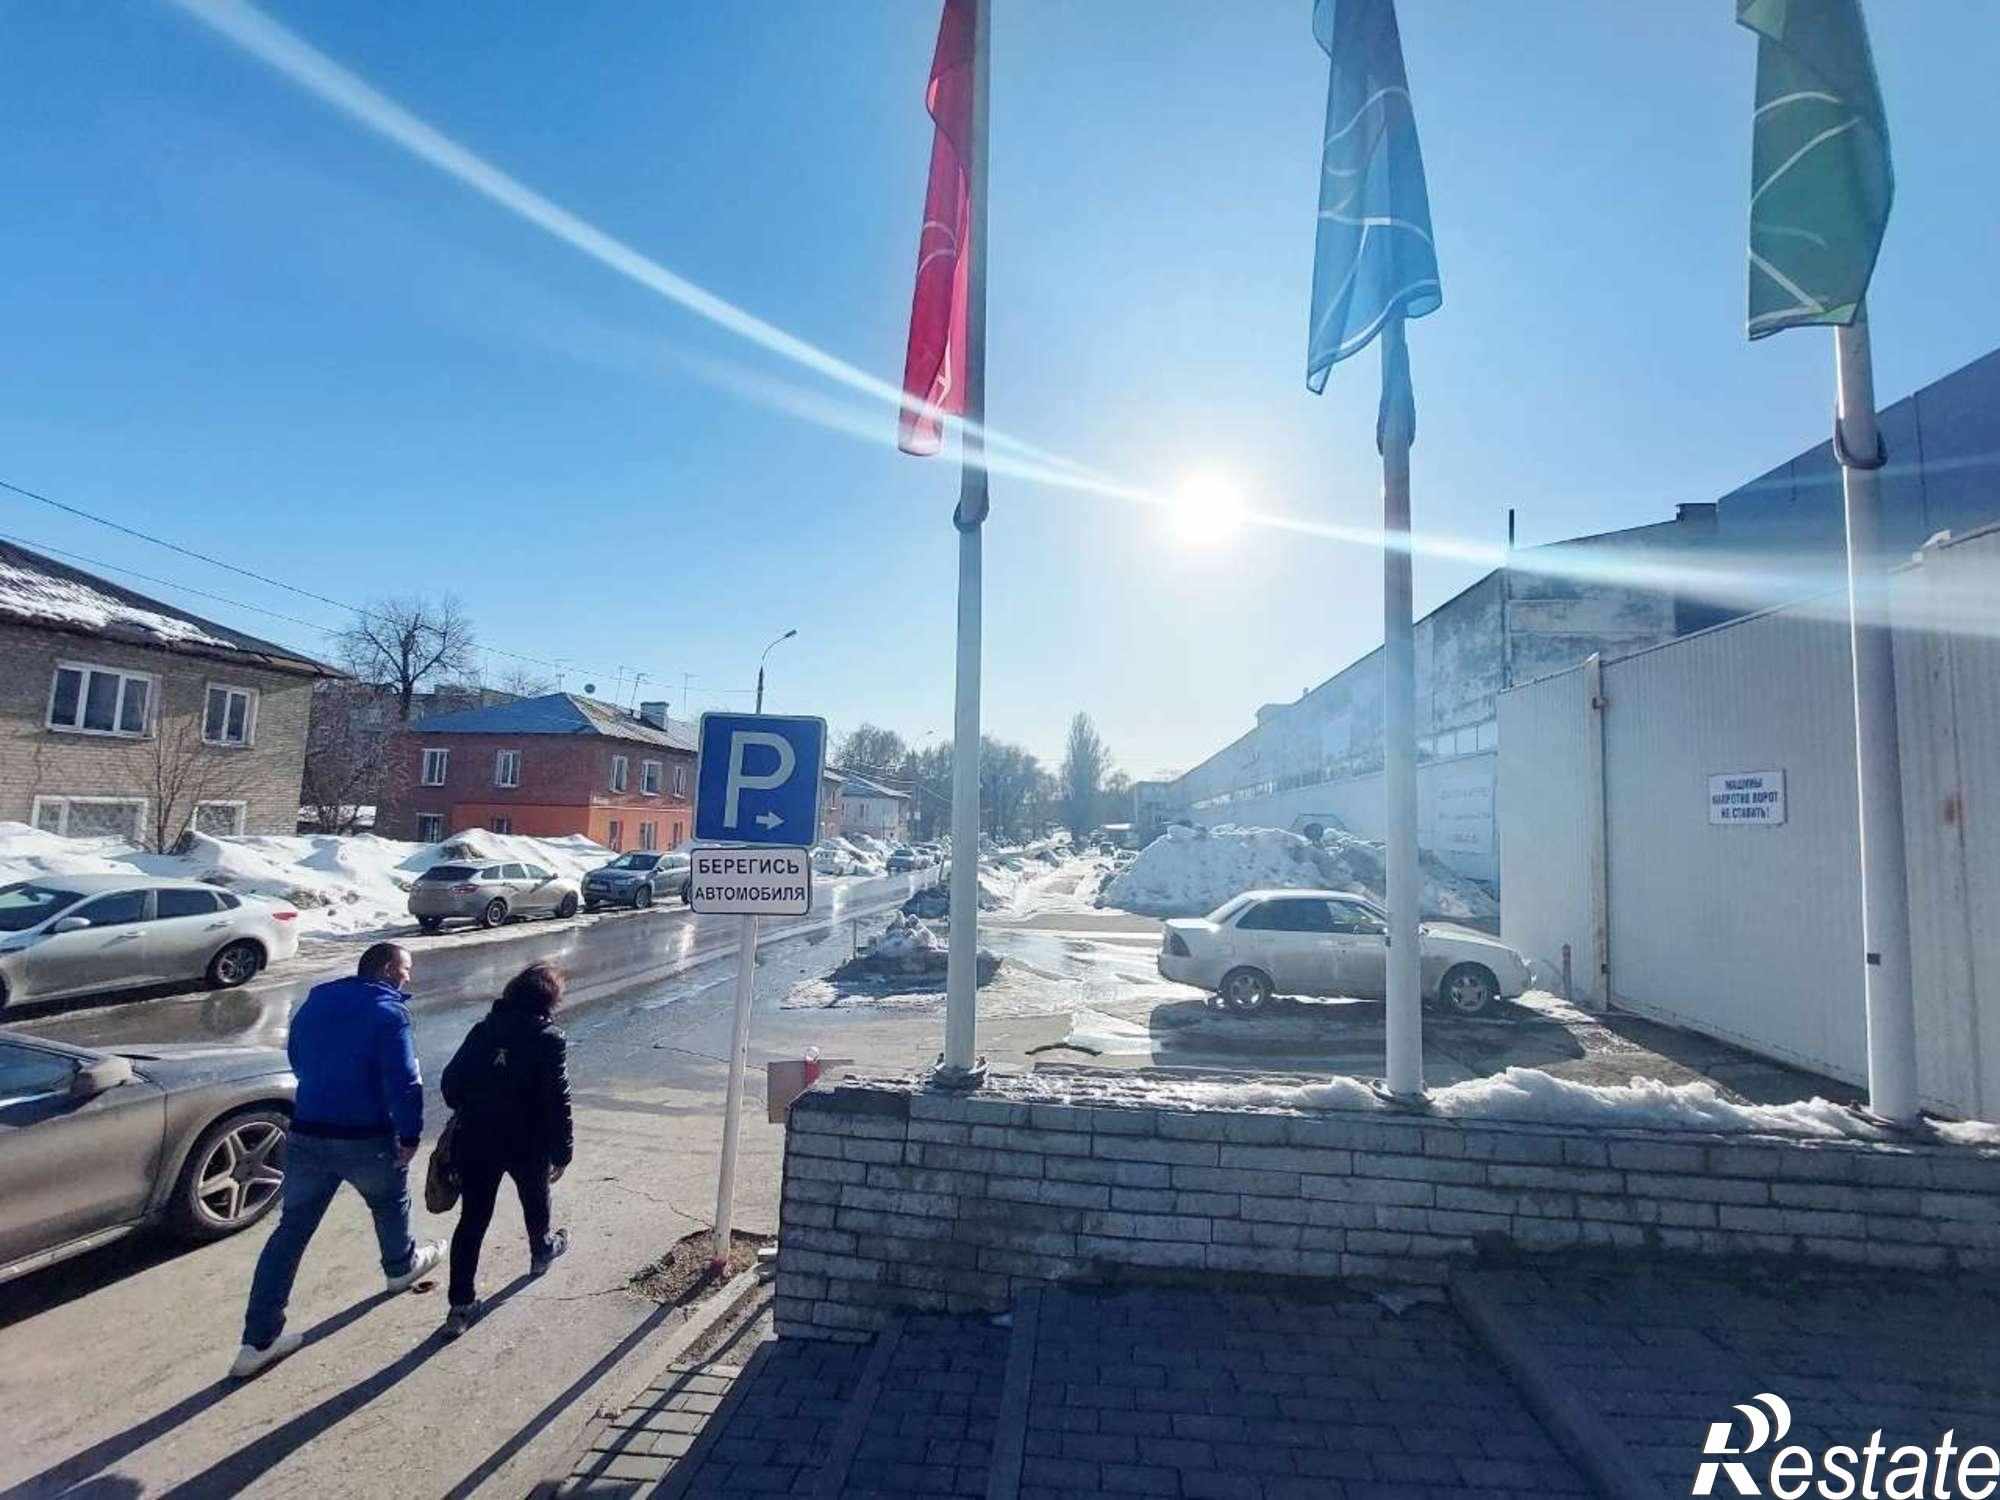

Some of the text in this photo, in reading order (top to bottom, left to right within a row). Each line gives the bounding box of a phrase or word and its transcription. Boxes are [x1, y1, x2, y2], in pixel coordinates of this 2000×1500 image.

[723, 730, 796, 829] P
[1753, 792, 1778, 803] ВОРОТ
[698, 858, 800, 874] БЕРЕГИСЬ
[694, 886, 806, 901] АВТОМОБИЛЯ
